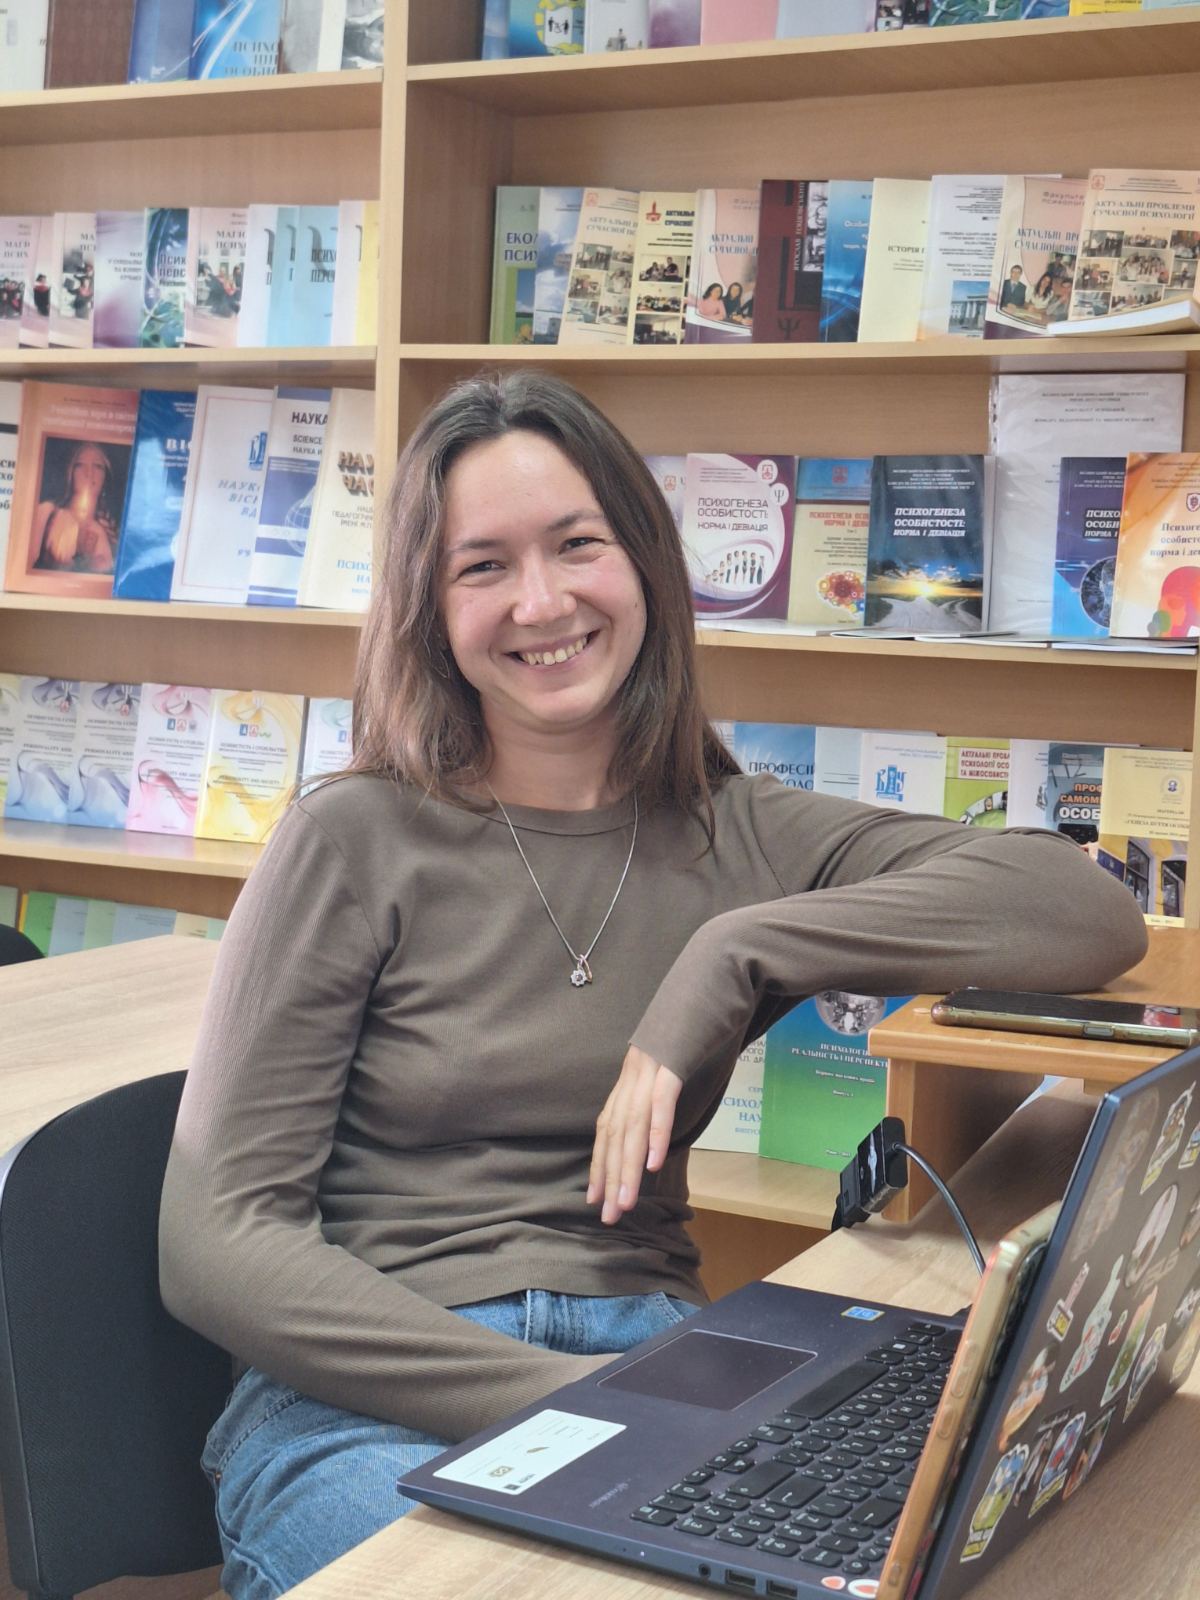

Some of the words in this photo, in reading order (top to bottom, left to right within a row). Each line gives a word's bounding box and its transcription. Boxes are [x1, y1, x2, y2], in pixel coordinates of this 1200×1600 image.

[1095, 200, 1144, 209] АКТУАЛЬНІ
[1146, 202, 1195, 212] ПРОБЛЕМИ
[1092, 208, 1137, 217] СУЧАСНОЇ
[1139, 211, 1195, 221] ПСИХОЛОГІЇ
[506, 232, 539, 245] ЕКО
[1017, 229, 1061, 241] АКТУАЛЬНІ
[291, 411, 328, 426] НАУКА
[293, 434, 323, 445] SCIENCE
[697, 497, 769, 508] ПСИХОГЕНЕЗА
[895, 507, 966, 517] ПСИХОГЕНЕЗА
[698, 522, 727, 530] НОРМА
[732, 523, 769, 532] ДЕВІАЦІЯ
[893, 528, 921, 537] НОРМА
[927, 529, 966, 538] ДЕВІАЦІЯ
